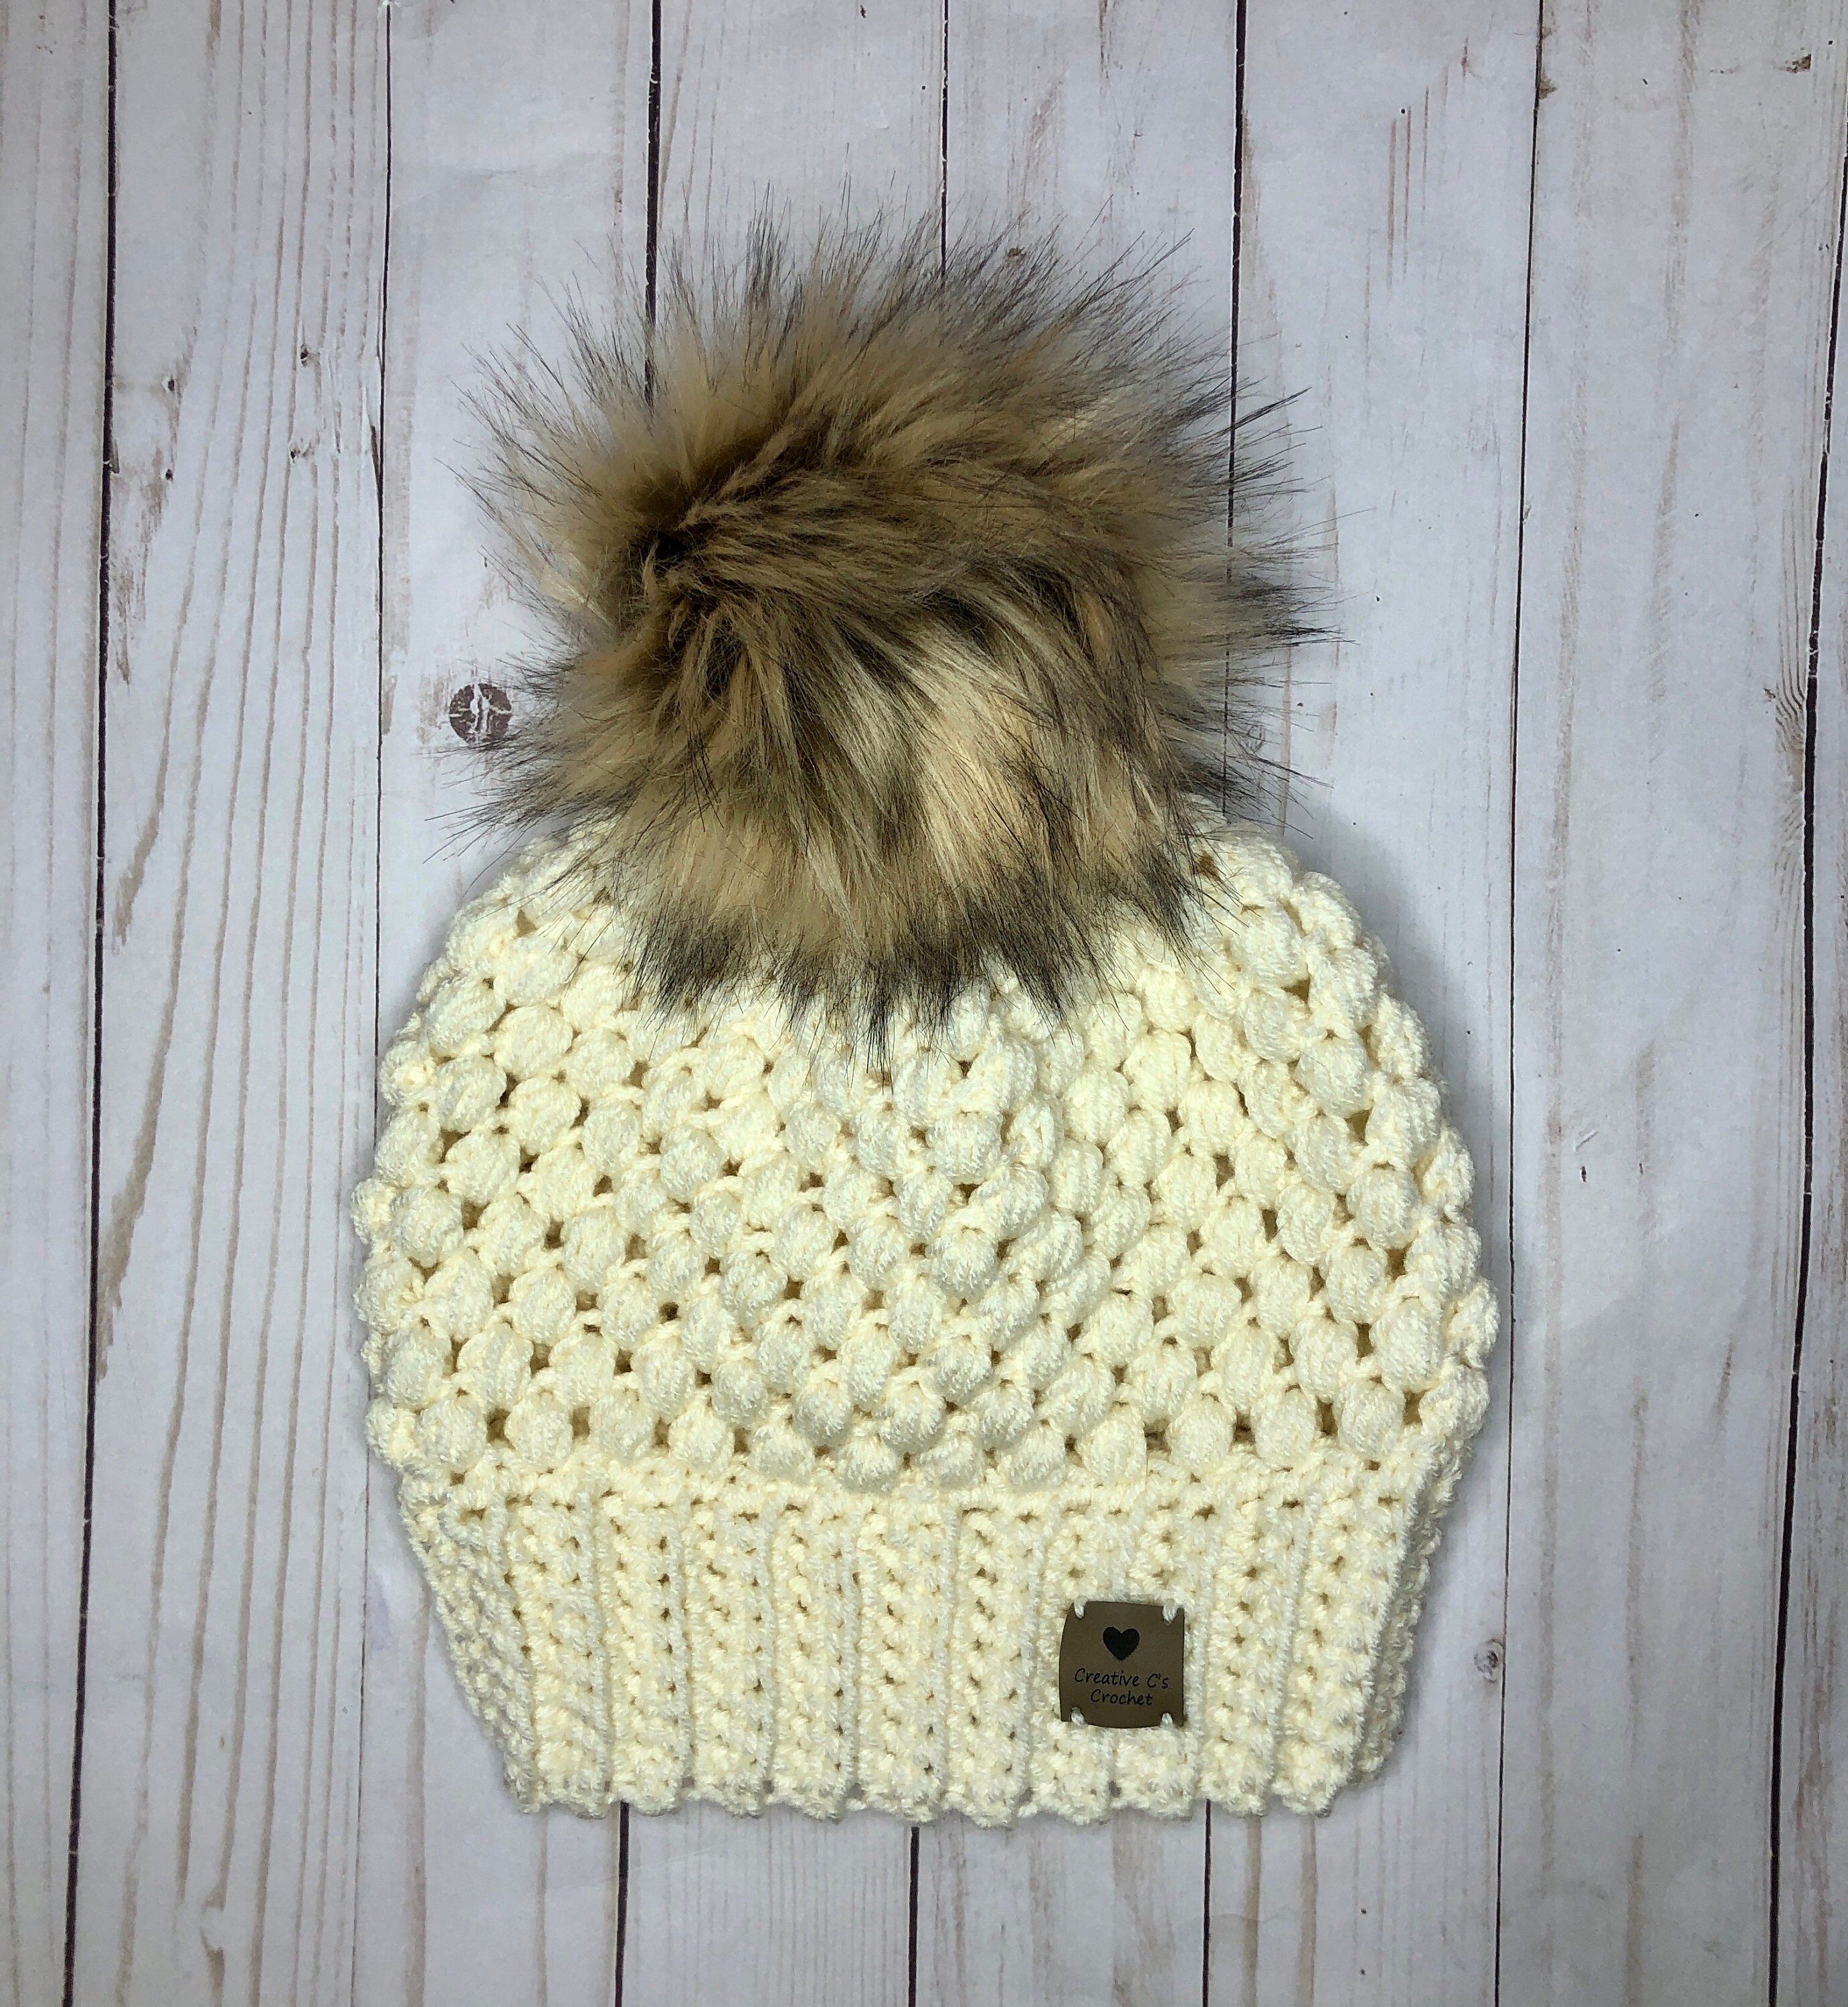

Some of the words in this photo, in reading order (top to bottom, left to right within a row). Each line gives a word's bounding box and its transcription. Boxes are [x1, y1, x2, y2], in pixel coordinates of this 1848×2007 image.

[1075, 1668, 1140, 1687] Creative
[1146, 1673, 1169, 1689] C's
[1090, 1689, 1153, 1705] Crochet
